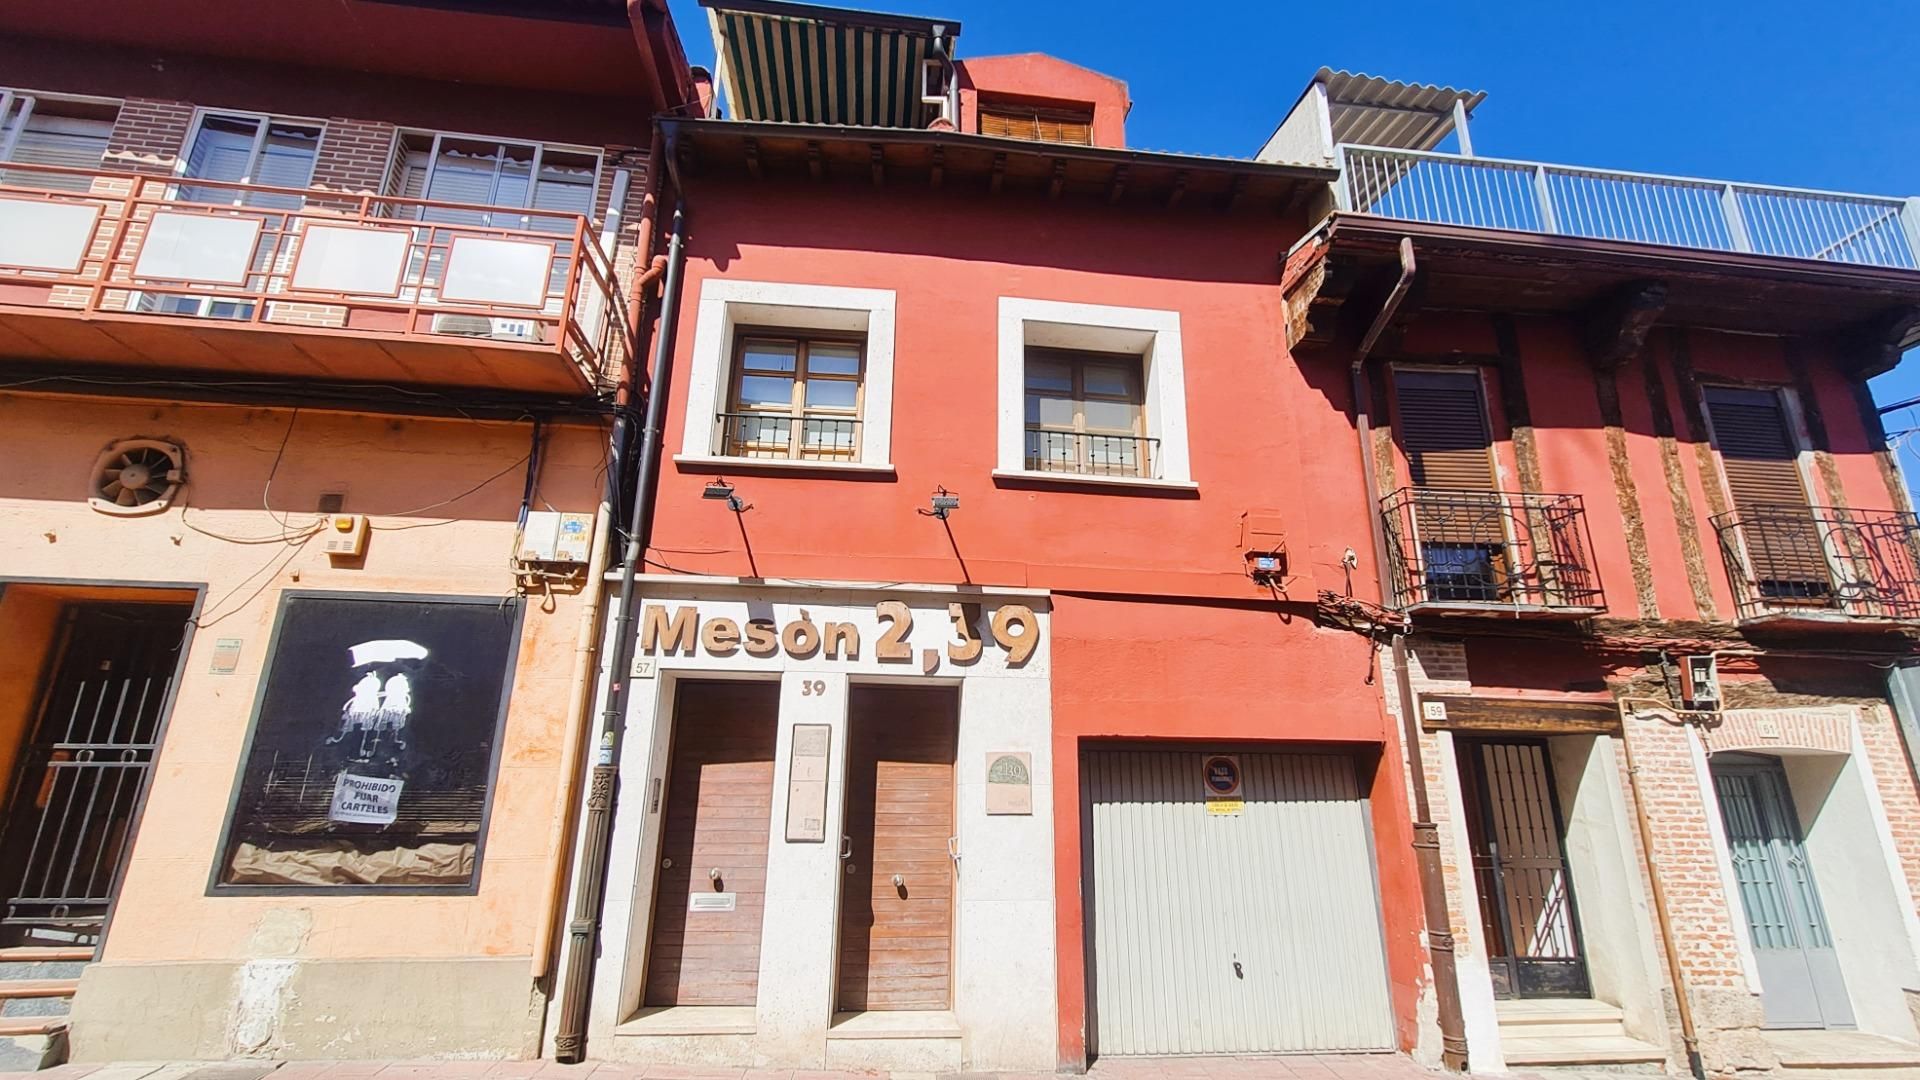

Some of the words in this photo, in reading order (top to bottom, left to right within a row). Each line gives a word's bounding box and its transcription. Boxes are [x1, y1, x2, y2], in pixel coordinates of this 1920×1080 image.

[635, 662, 650, 674] 57
[801, 679, 827, 697] 39
[1430, 705, 1443, 717] 59
[342, 778, 397, 793] PROHIBIDO
[341, 801, 389, 814] CARTELES
